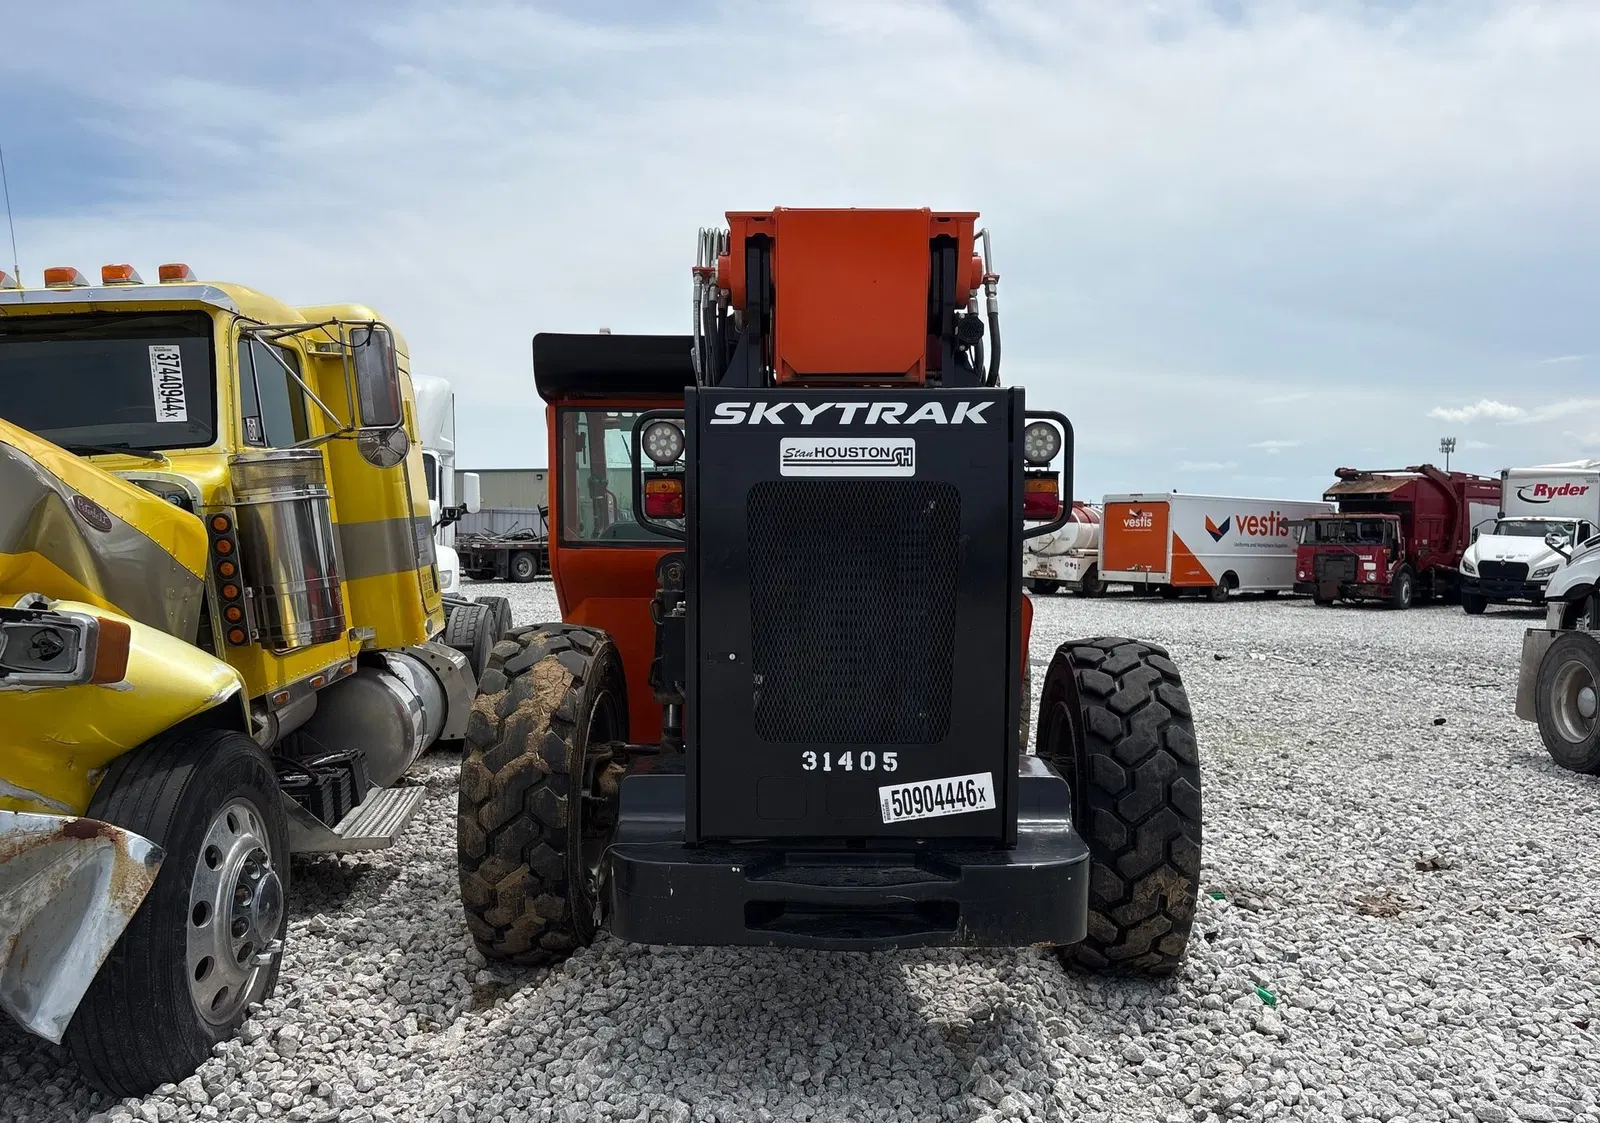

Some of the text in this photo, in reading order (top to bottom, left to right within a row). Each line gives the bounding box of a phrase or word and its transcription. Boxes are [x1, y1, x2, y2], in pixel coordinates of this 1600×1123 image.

[710, 401, 996, 425] SKYTRAK
[783, 447, 814, 459] Stan
[814, 446, 890, 458] HOUSTON
[1533, 483, 1590, 499] Ryder
[1123, 516, 1152, 528] vestis
[1235, 510, 1289, 537] vestis
[801, 750, 898, 772] 31405
